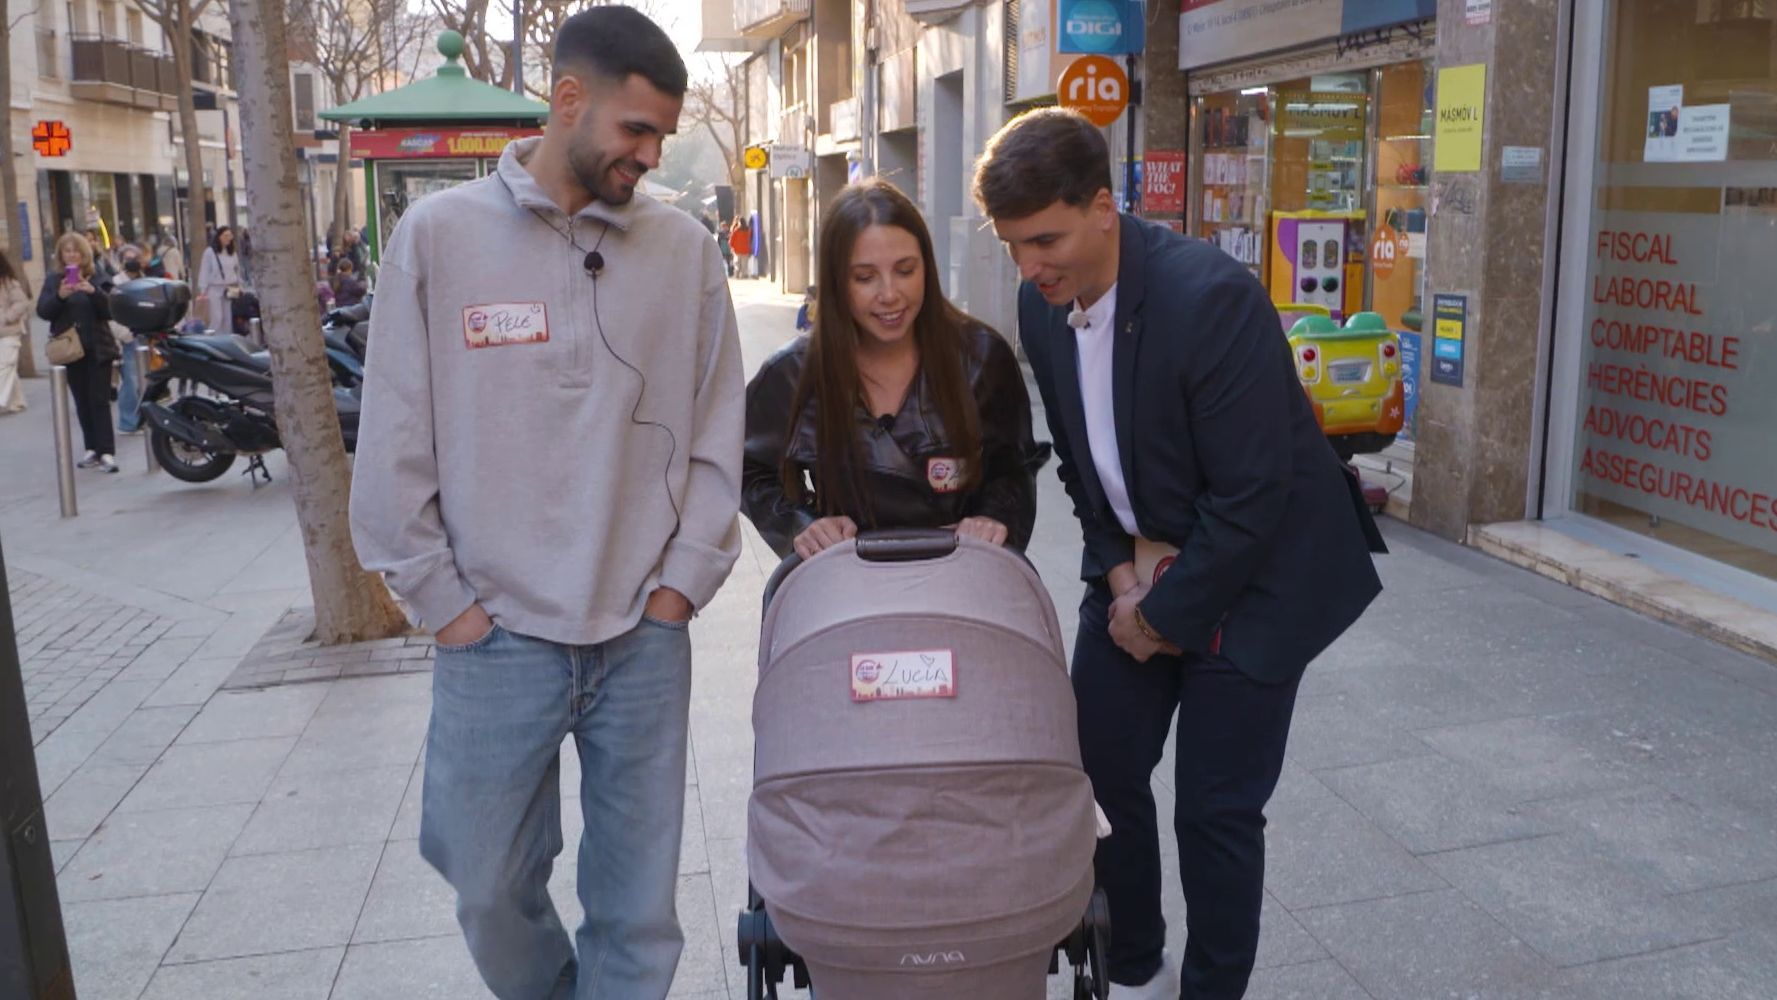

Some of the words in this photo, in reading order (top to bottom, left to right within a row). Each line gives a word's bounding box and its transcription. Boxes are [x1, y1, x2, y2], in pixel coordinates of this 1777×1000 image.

[1066, 20, 1122, 36] DIGI
[1069, 65, 1120, 101] ria
[1147, 161, 1182, 173] WHAT
[1148, 172, 1169, 183] THE
[1147, 183, 1177, 194] FOC!
[1374, 230, 1395, 260] ria
[1597, 230, 1678, 265] FISCAL
[1593, 275, 1703, 315] LABORAL
[1591, 318, 1740, 370] COMPTABLE
[1587, 362, 1728, 417] HERÈNCIES
[1583, 404, 1713, 462] ADVOCATS
[900, 950, 966, 965] nuna
